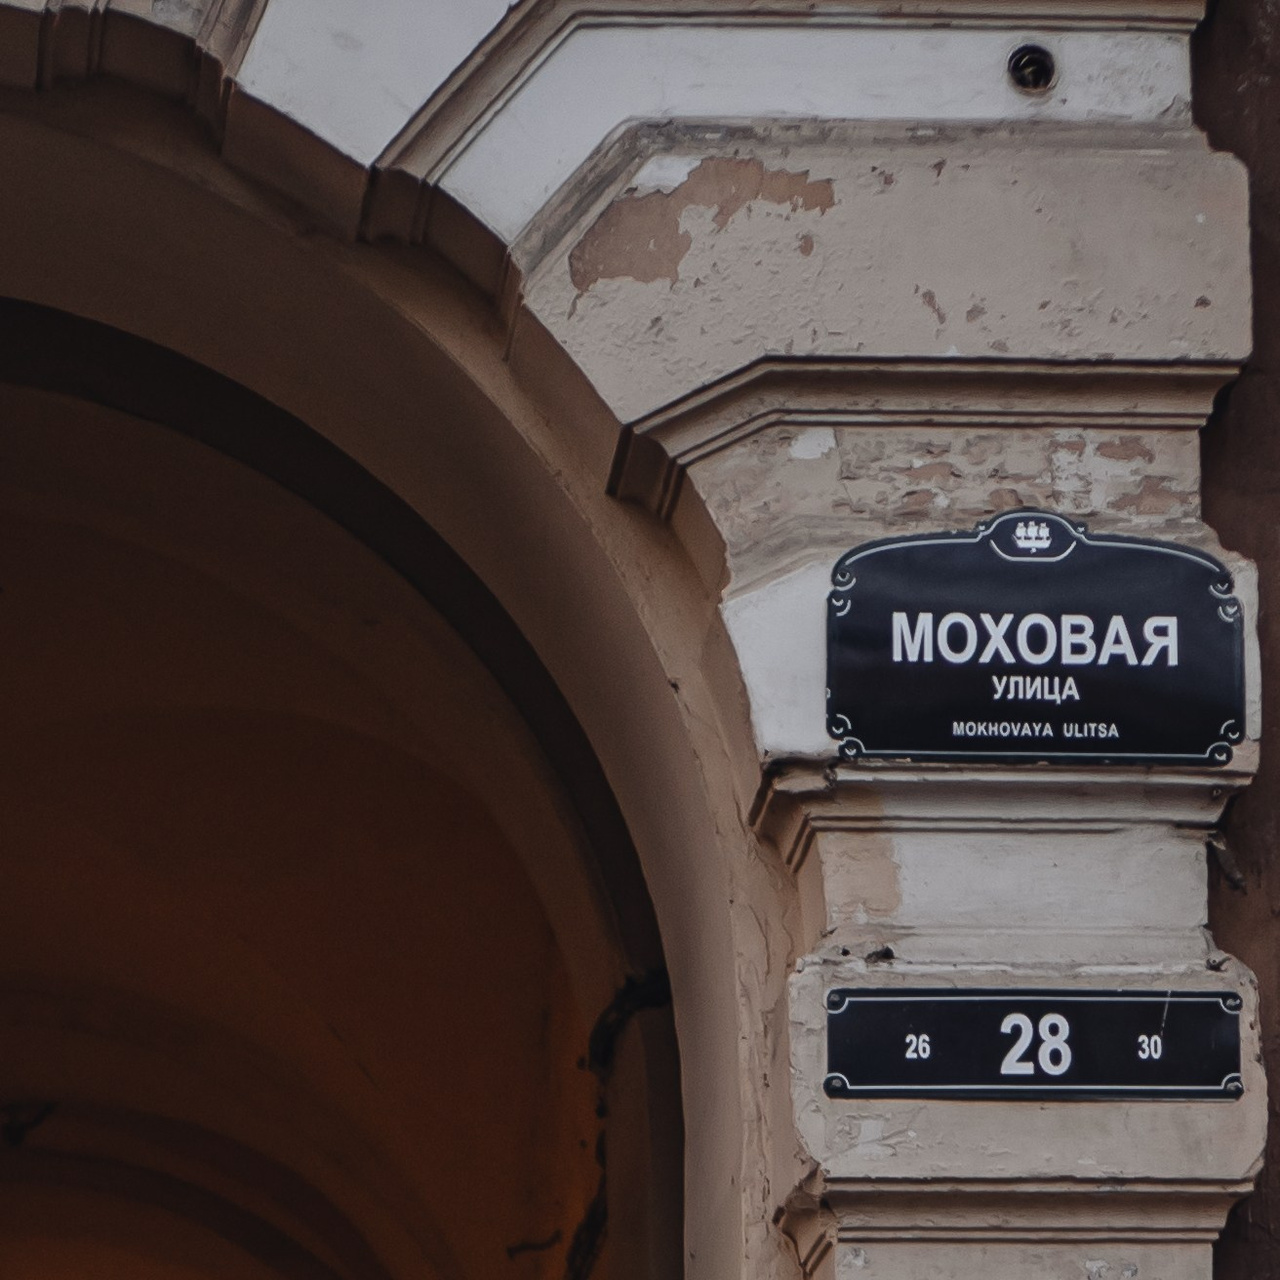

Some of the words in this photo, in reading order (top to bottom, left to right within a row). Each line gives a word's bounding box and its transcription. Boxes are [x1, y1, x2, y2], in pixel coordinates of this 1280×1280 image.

[892, 611, 1179, 667] МОХОВАЯ
[991, 675, 1081, 705] УЛИЦА
[952, 721, 1054, 738] MOKHOVAYA
[1063, 722, 1120, 739] ULITSA
[905, 1033, 931, 1060] 26
[1000, 1012, 1073, 1076] 28
[1137, 1035, 1163, 1060] 30
